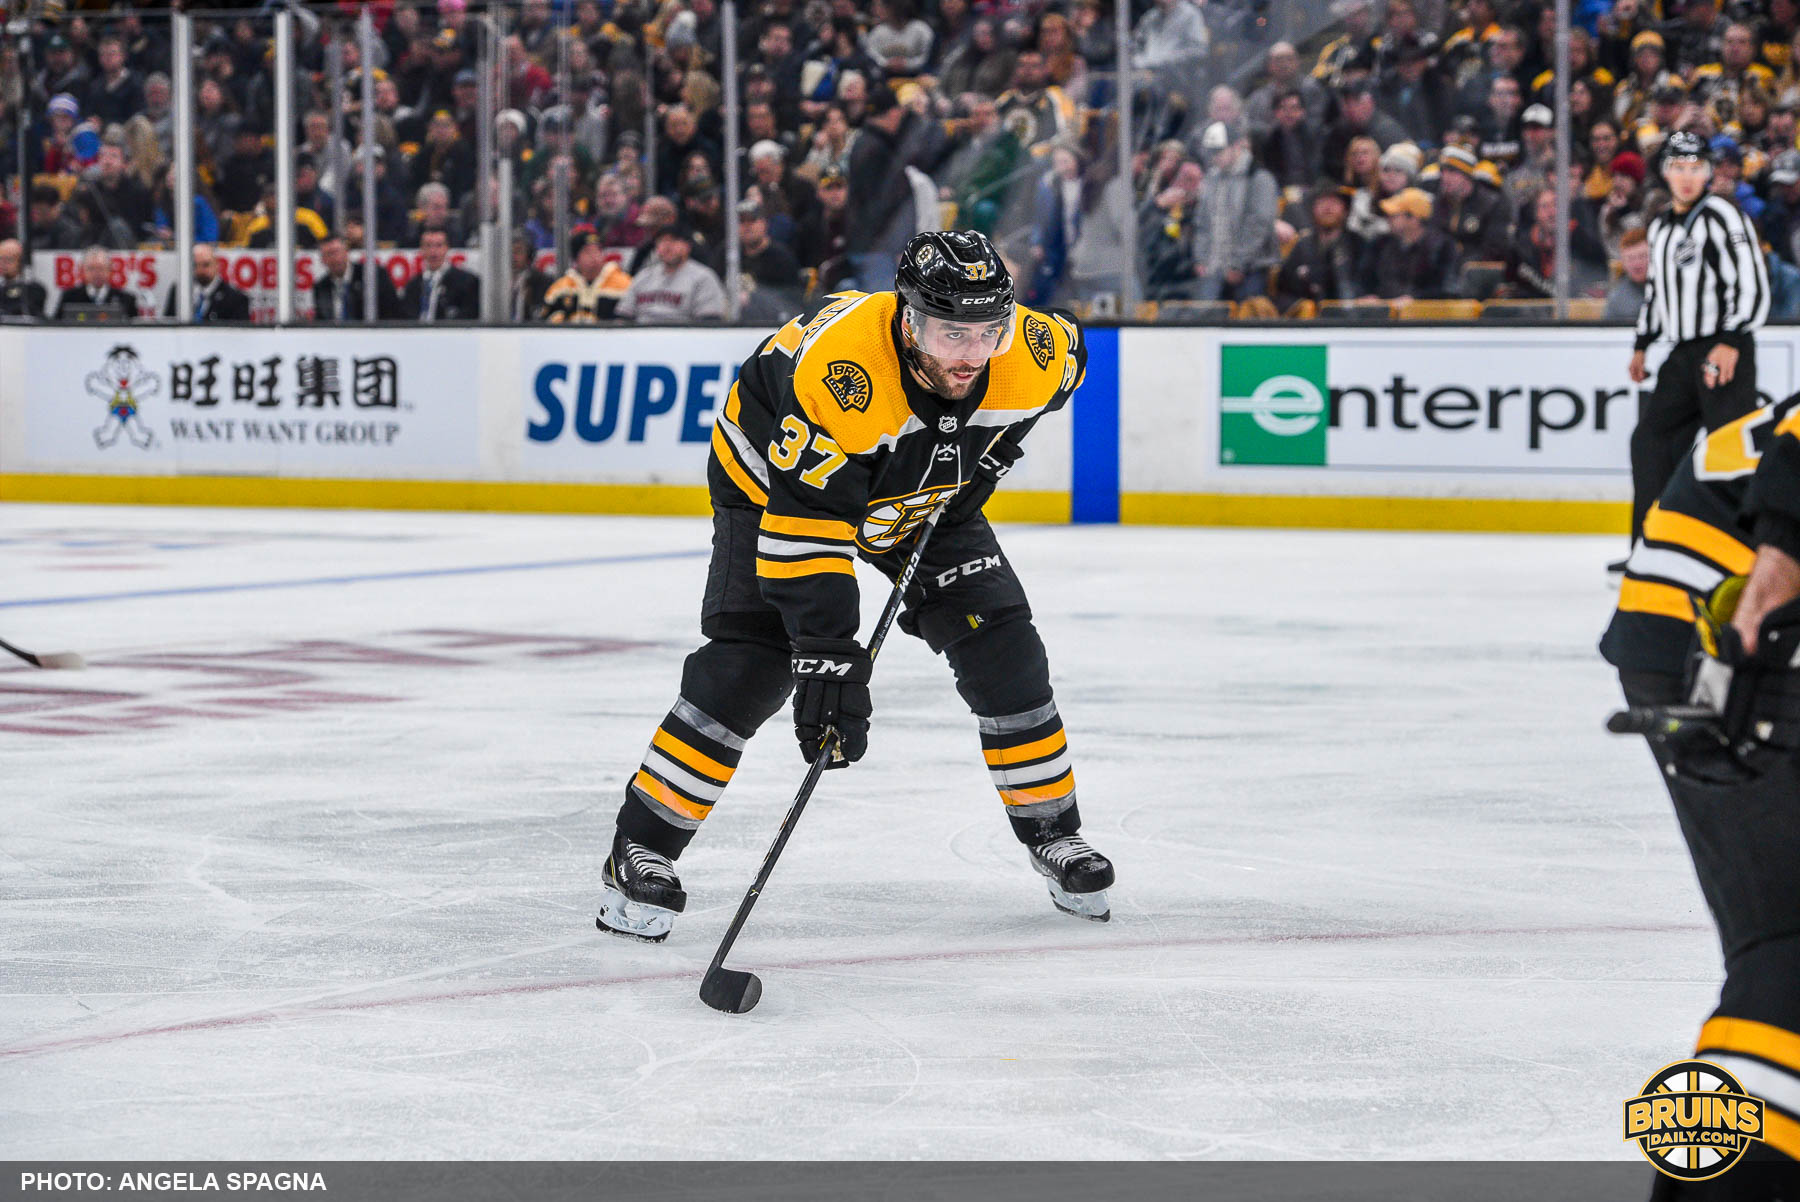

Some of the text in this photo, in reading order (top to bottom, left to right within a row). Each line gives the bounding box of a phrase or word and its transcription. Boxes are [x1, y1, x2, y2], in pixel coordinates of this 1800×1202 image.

[54, 256, 157, 290] BB'S
[966, 264, 987, 280] 37
[962, 296, 996, 305] CCM
[1028, 319, 1047, 363] BRUINS
[170, 356, 398, 408] 旺旺集团
[833, 365, 867, 405] BRUINS
[527, 363, 743, 443] SUPE
[170, 419, 400, 446] WANT WANT GROUP
[768, 414, 848, 490] 37
[900, 551, 920, 593] CCM
[936, 554, 1001, 588] CCM
